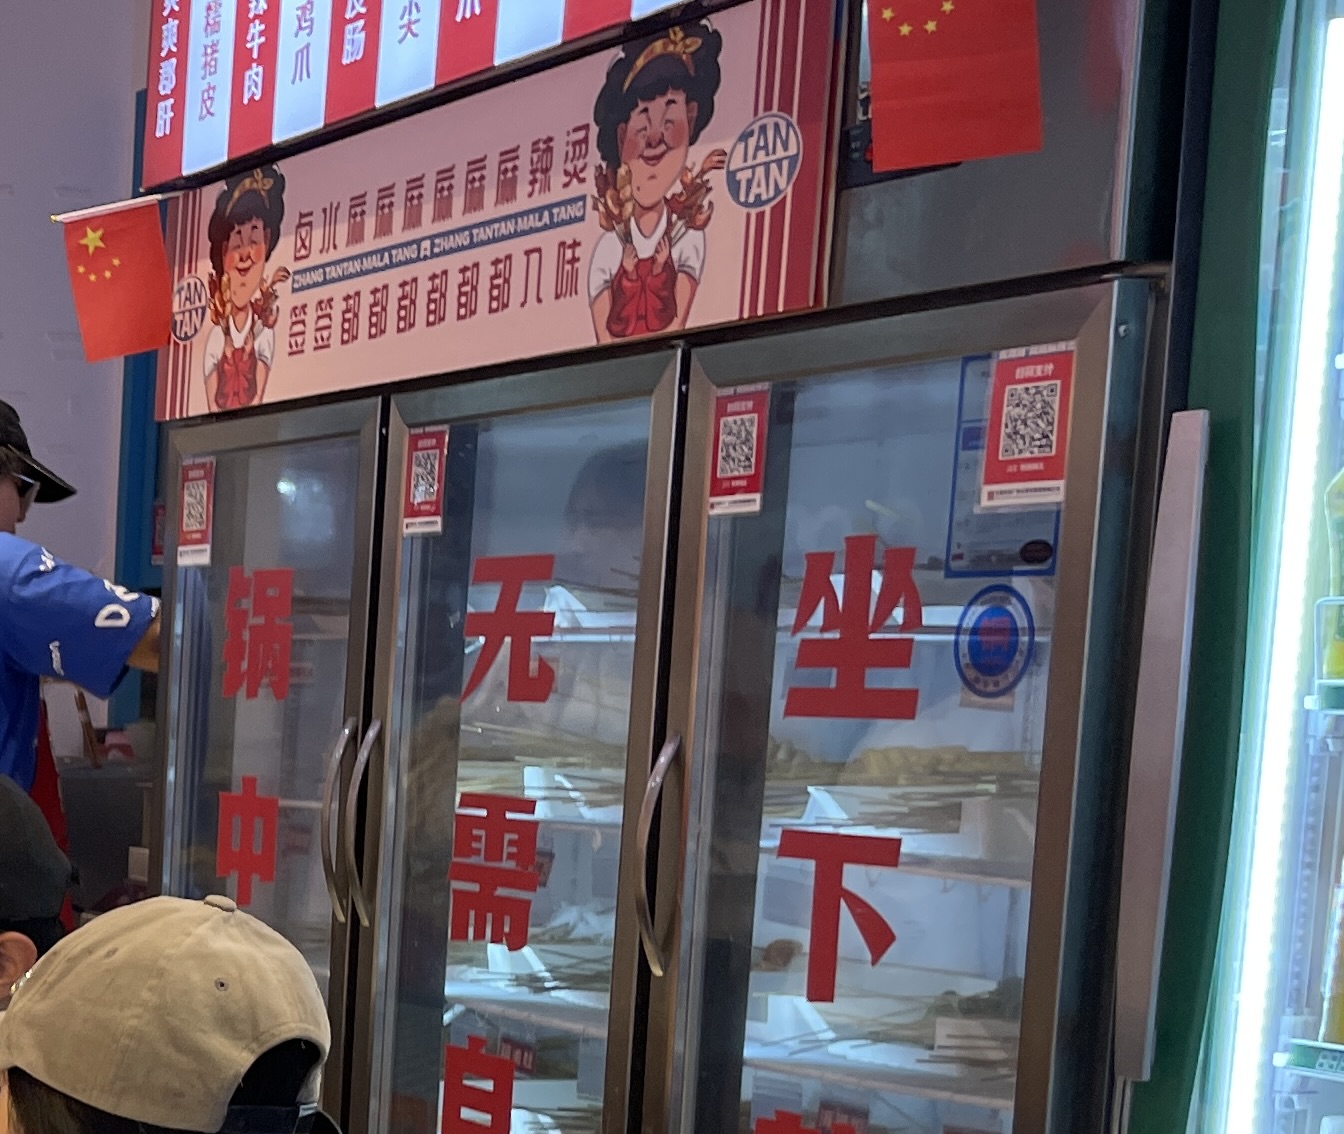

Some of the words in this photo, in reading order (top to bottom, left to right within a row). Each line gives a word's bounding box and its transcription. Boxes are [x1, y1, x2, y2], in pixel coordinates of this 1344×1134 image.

[737, 121, 793, 163] TAN
[735, 159, 791, 203] TAN
[292, 268, 324, 289] ZHANG
[391, 243, 418, 261] TANG
[433, 231, 470, 253] ZHANG
[552, 199, 585, 224] TANG
[176, 282, 203, 310] TAN
[174, 308, 202, 337] TAN
[216, 566, 296, 905] 锅中
